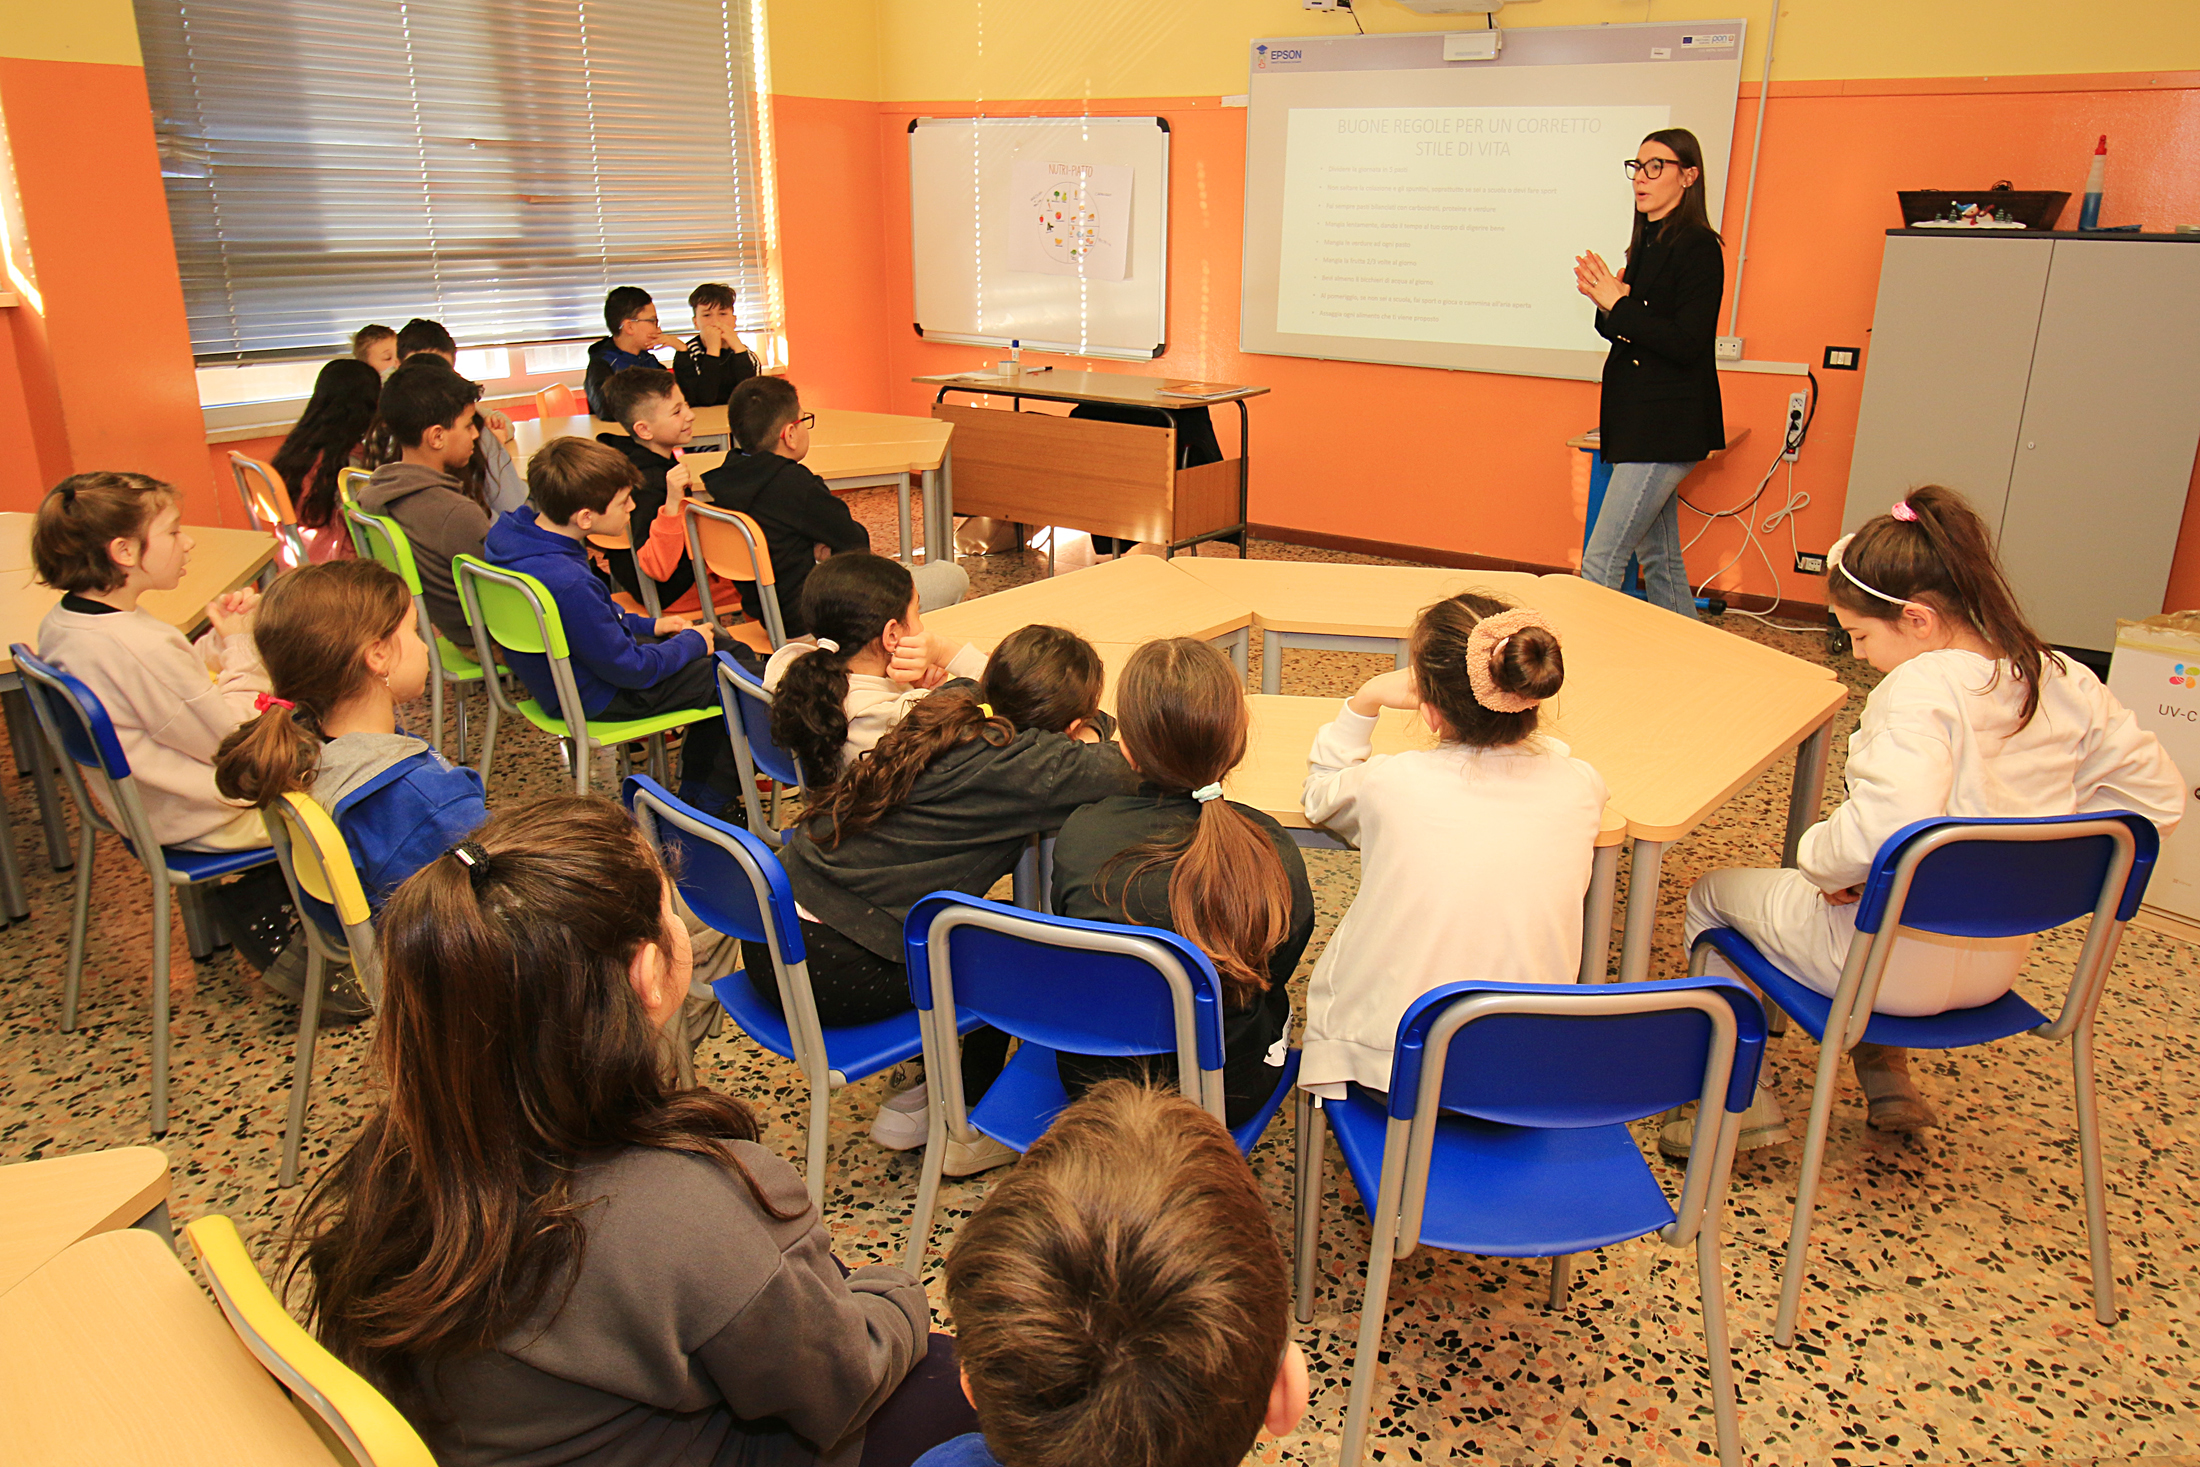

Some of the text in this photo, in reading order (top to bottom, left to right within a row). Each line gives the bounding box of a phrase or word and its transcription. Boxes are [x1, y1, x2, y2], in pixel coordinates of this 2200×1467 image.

[1271, 50, 1302, 60] EPSON
[1338, 118, 1601, 134] BUONE REGOLE PER UN CORRETTO
[1415, 141, 1510, 156] STILE DI VITA
[1327, 293, 1358, 302] pomeriggio,
[2158, 704, 2198, 722] UV-C
